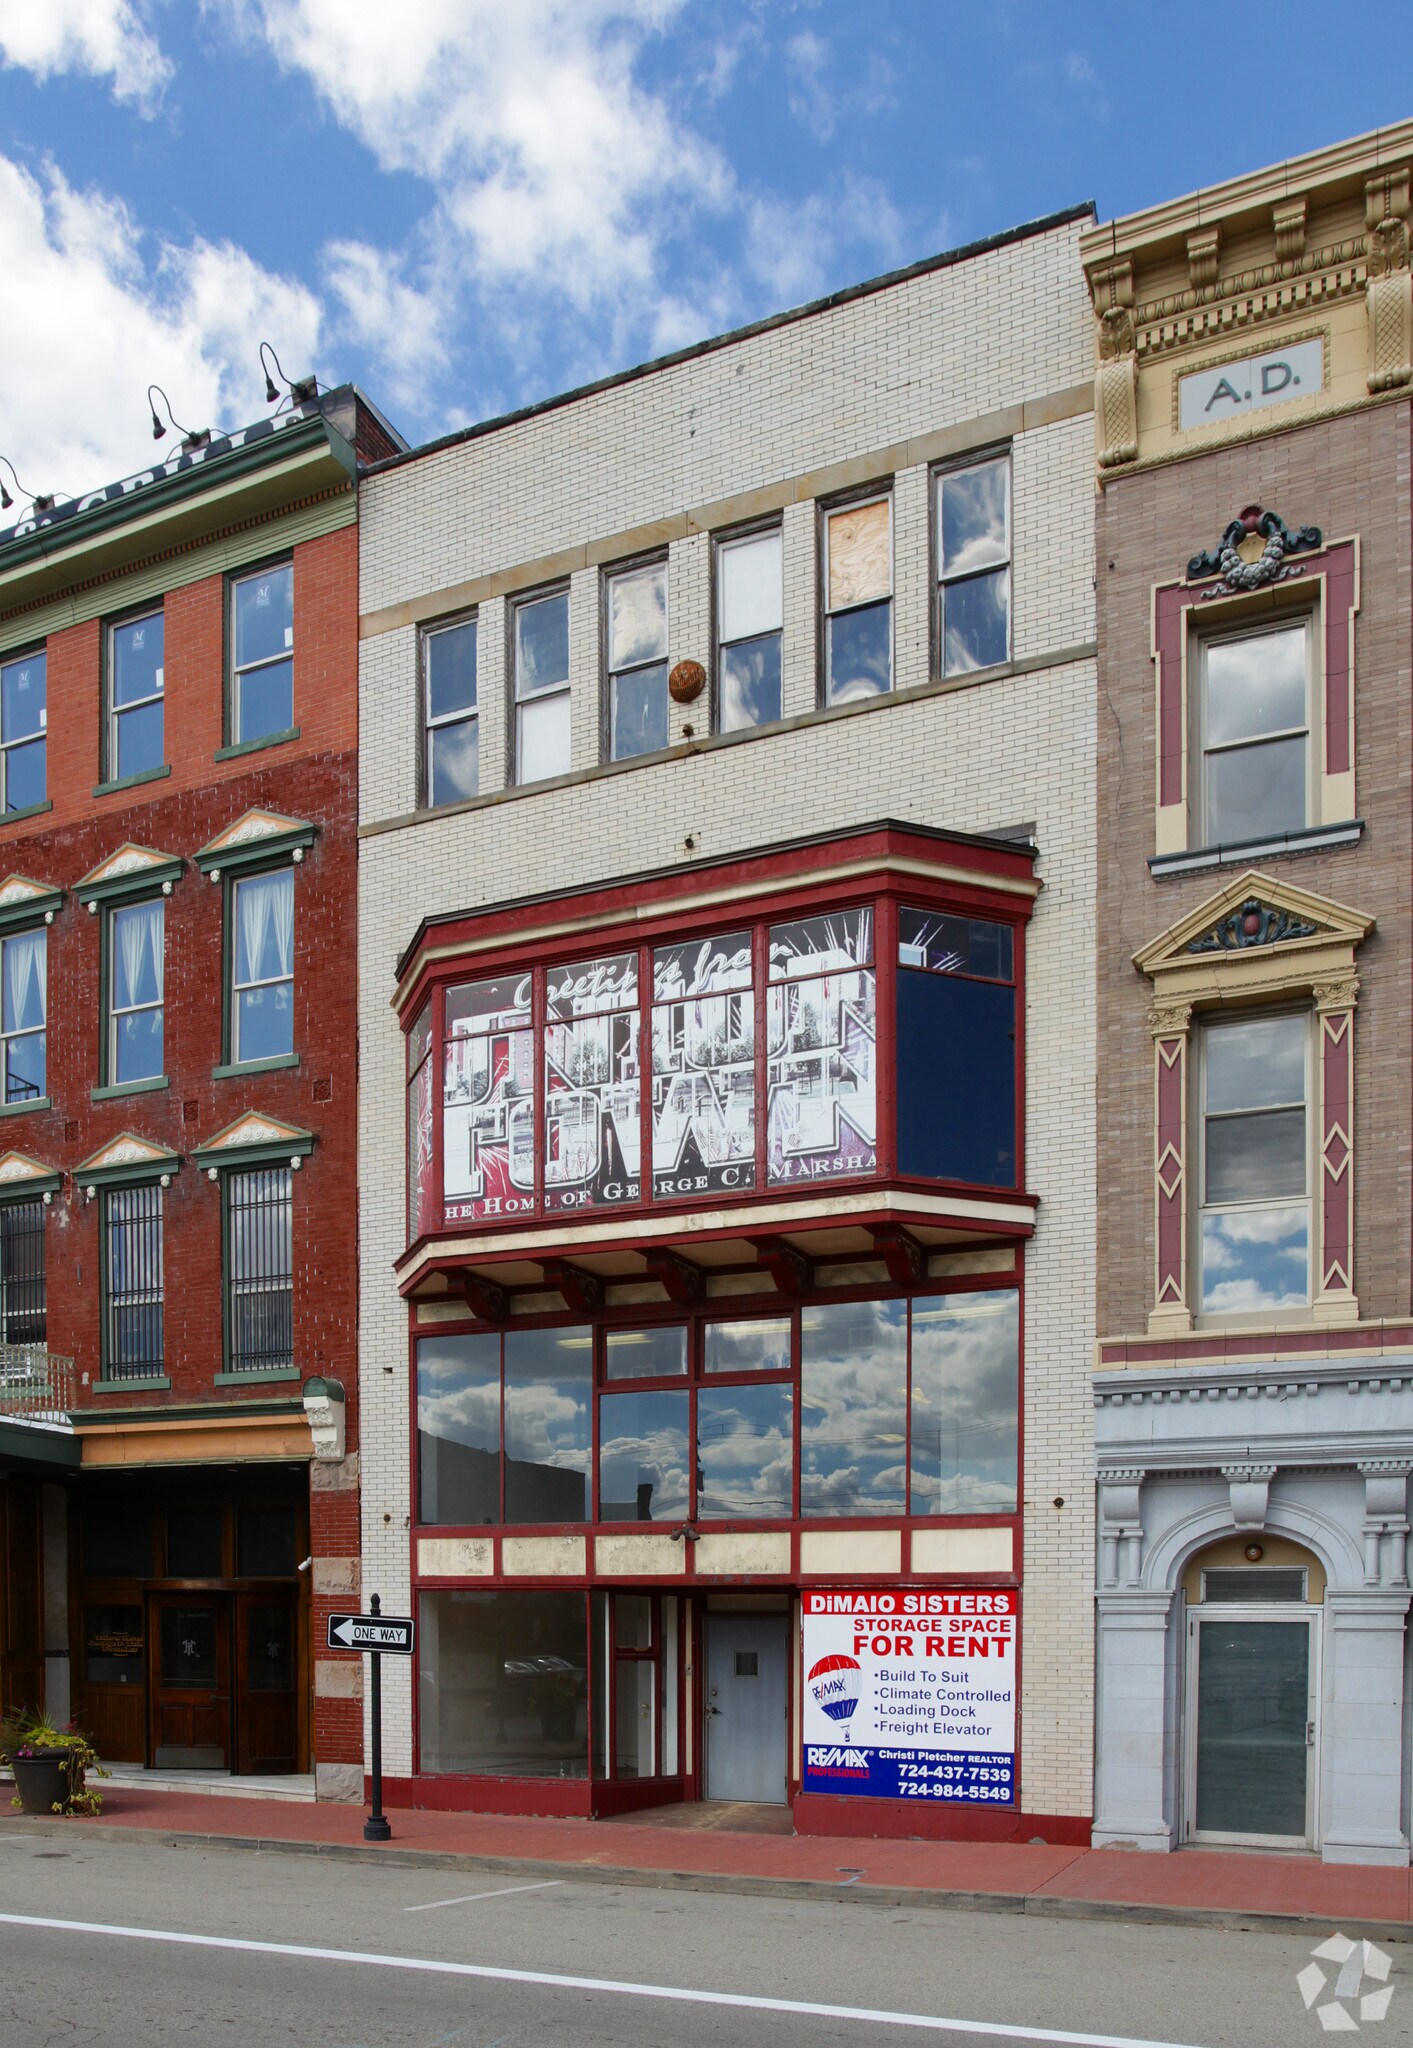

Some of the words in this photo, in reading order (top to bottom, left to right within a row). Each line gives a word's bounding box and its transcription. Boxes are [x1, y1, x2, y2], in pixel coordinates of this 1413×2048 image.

[1204, 361, 1301, 412] A.D.
[444, 1204, 473, 1221] HE
[810, 1595, 896, 1613] DiMAIO
[903, 1595, 1010, 1613] SISTERS
[854, 1618, 942, 1632] STORAGE
[949, 1619, 1011, 1633] SPACE
[354, 1627, 376, 1640] ONE
[380, 1628, 404, 1642] WAY
[853, 1635, 914, 1656] FOR
[925, 1636, 1011, 1658] RENT
[880, 1670, 915, 1682] Build
[920, 1671, 937, 1682] To
[941, 1671, 969, 1683] Suit
[880, 1687, 932, 1700] Climate
[936, 1689, 1011, 1702] Controlled
[880, 1704, 936, 1718] Loading
[940, 1705, 976, 1718] Dock
[880, 1721, 929, 1735] Freight
[934, 1723, 992, 1736] Elevator
[878, 1750, 915, 1761] Christi
[918, 1752, 965, 1763] Pletcher
[968, 1755, 1011, 1765] REALTOR
[807, 1766, 870, 1779] PROFESSIONALS
[898, 1764, 1011, 1782] 724-437-7539
[898, 1782, 1011, 1800] 724-984-5549
